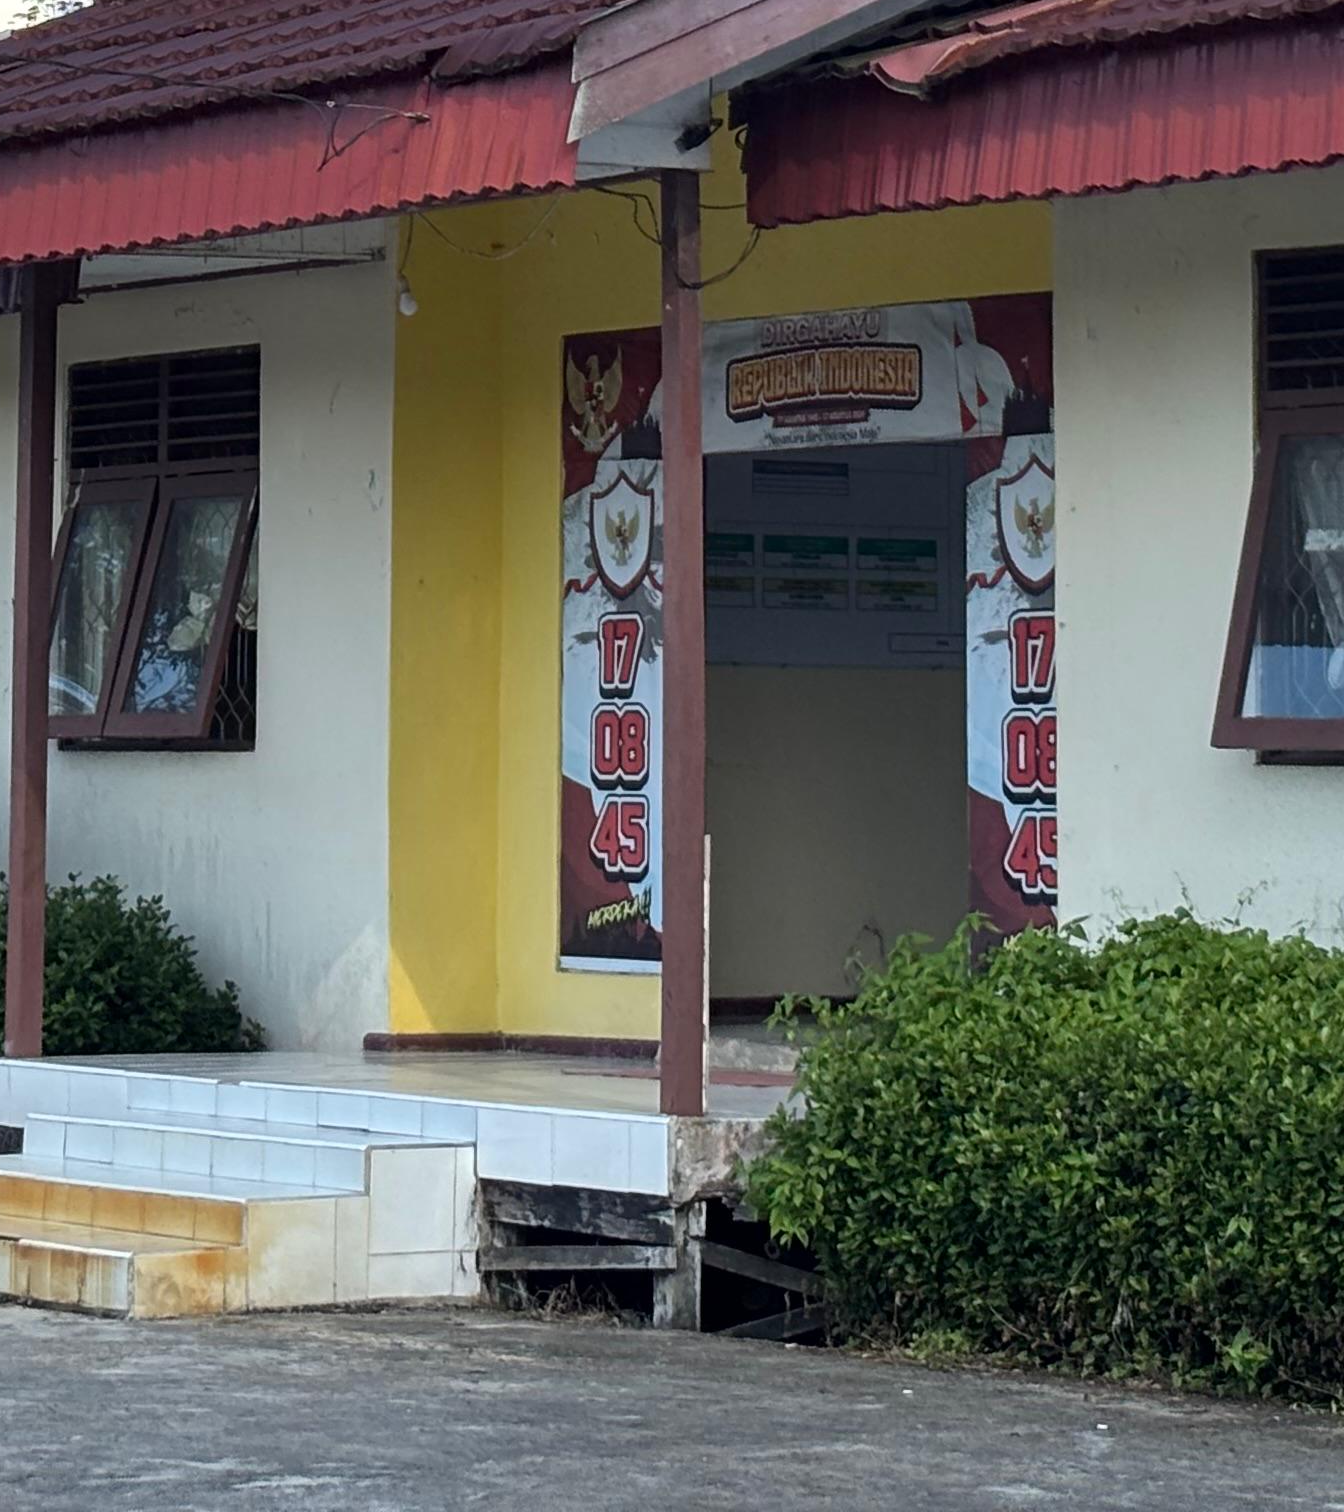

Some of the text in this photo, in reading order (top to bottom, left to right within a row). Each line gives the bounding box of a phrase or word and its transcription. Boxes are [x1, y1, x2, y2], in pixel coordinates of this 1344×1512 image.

[761, 310, 882, 347] DIRGAHAYU
[732, 347, 917, 410] REPUBLIK INDONESIA
[599, 613, 644, 690] 17
[1010, 610, 1056, 694] 17
[591, 704, 649, 781] 08
[590, 795, 649, 873] 45
